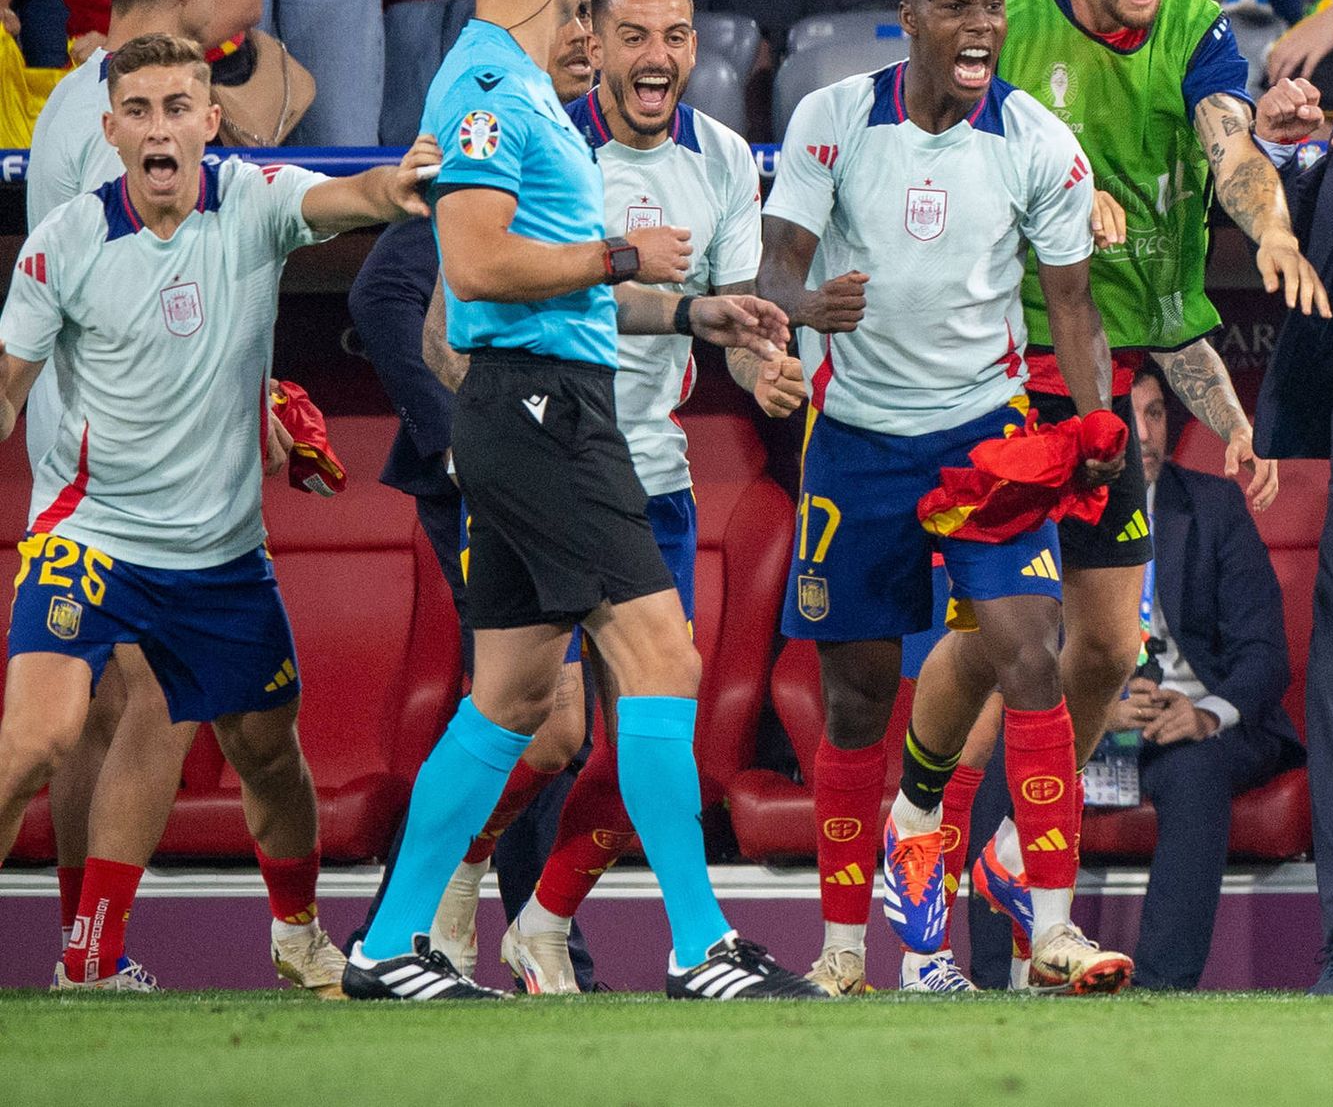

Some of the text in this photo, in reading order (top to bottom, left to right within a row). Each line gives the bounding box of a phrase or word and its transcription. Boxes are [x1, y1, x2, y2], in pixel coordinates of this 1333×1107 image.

[798, 492, 842, 563] 17
[38, 535, 114, 607] 25
[88, 897, 110, 960] TAPEDESIGN
